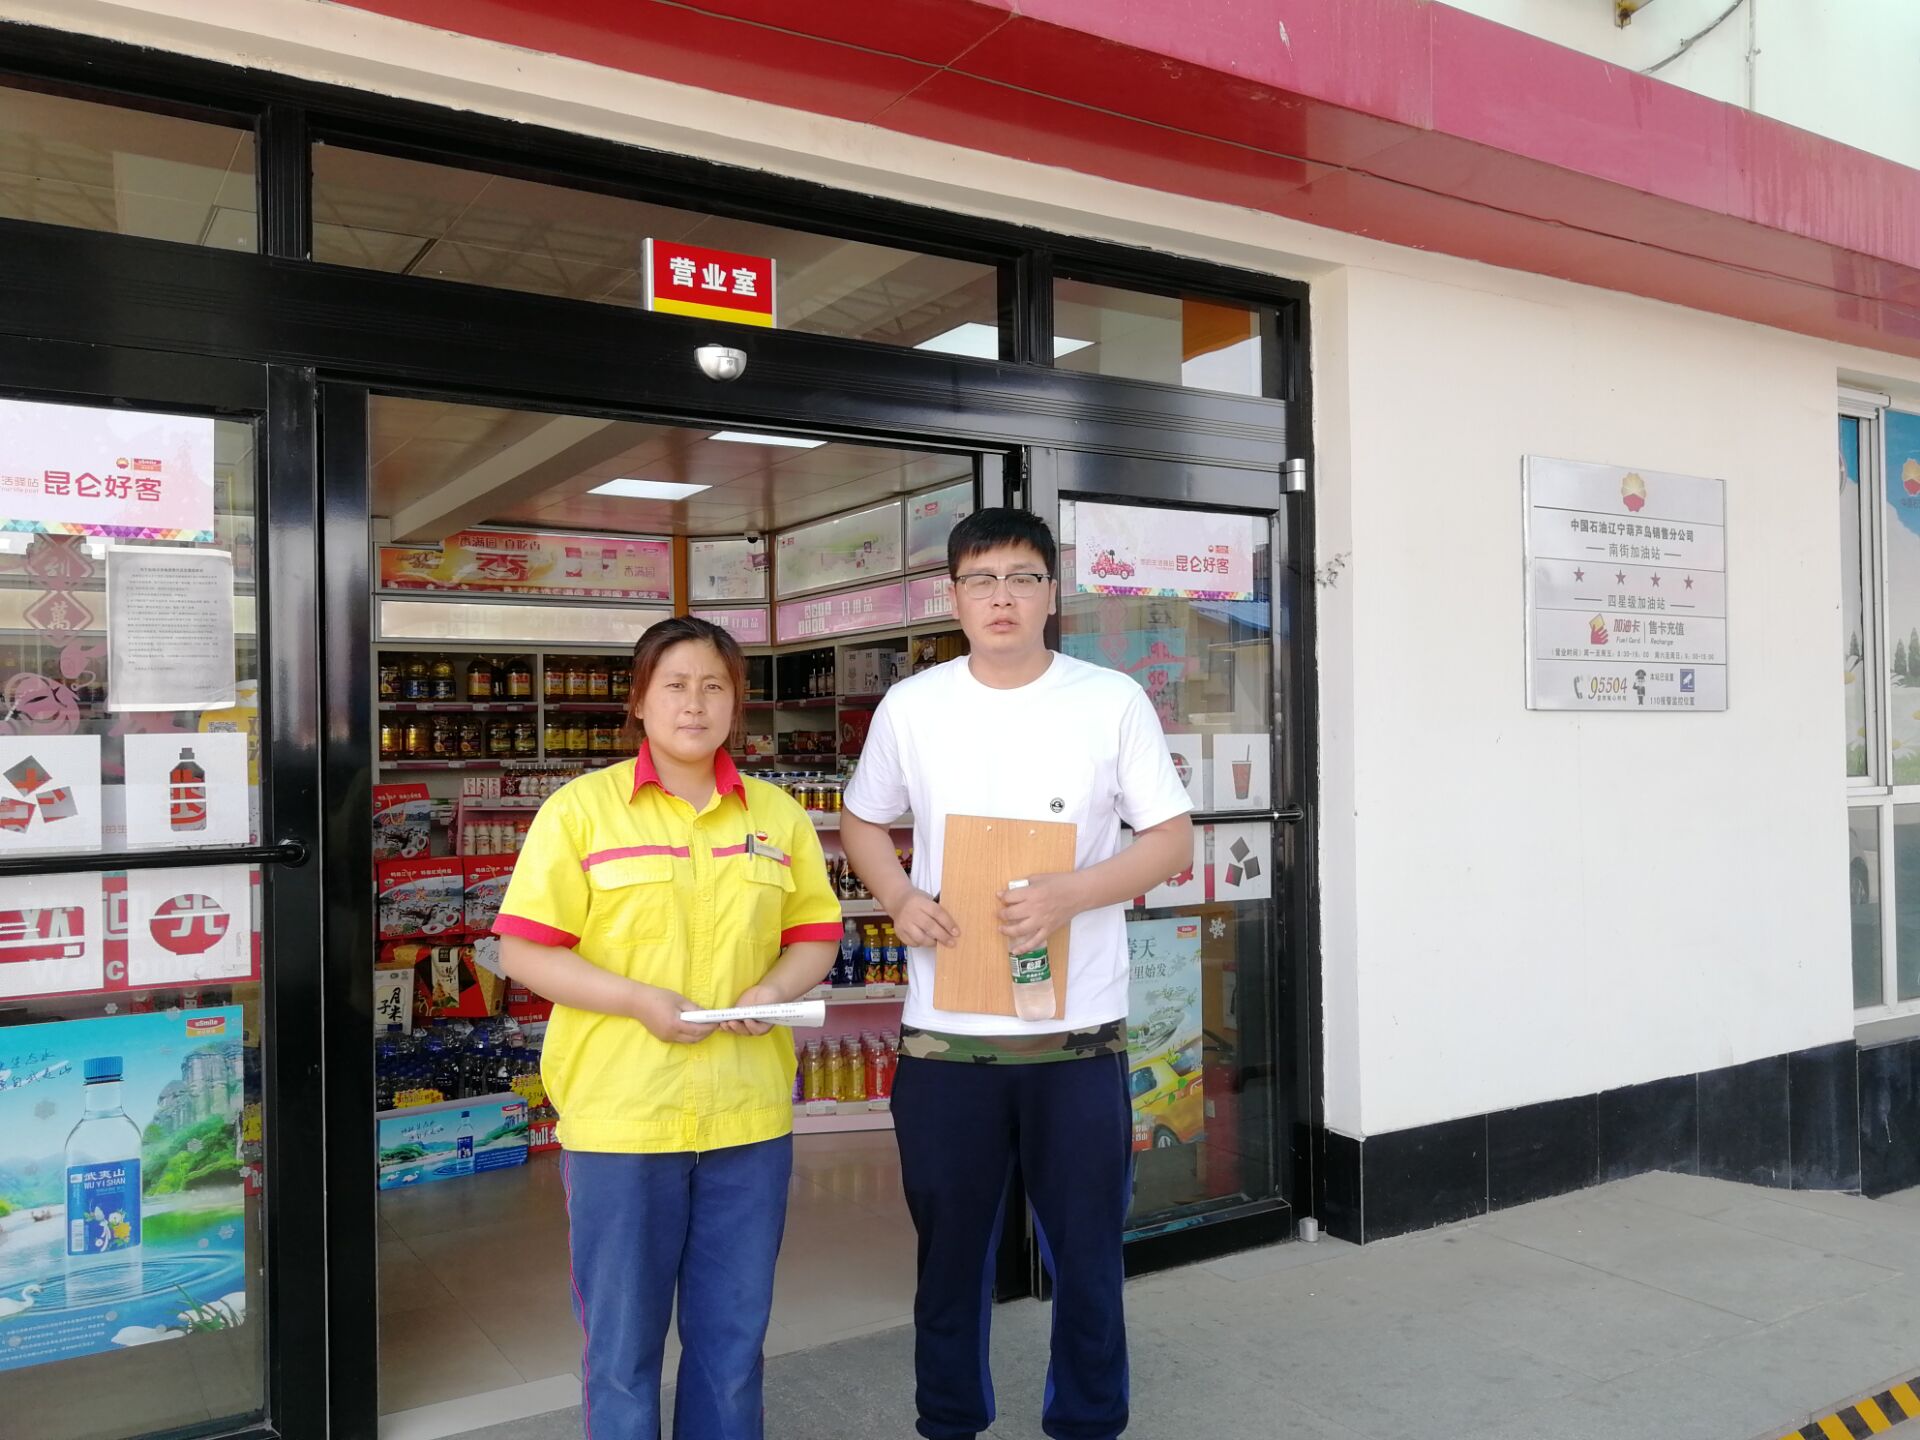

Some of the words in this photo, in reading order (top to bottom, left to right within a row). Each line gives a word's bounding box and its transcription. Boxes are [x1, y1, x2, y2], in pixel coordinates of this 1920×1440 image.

[669, 256, 758, 297] 营业室
[44, 470, 162, 501] 昆仑好客
[1571, 518, 1694, 542] 中国石油辽宁葫芦岛销售分公司
[1608, 543, 1661, 560] 南街加油站
[1176, 555, 1229, 574] 昆仑好客
[1608, 594, 1665, 610] 四星级加油站
[1613, 619, 1641, 633] 加油卡
[1648, 621, 1685, 636] 售卡充值
[1588, 676, 1627, 700] 95504
[530, 1127, 549, 1147] Bull
[83, 1169, 126, 1181] 武夷山
[106, 1177, 126, 1187] SHAN
